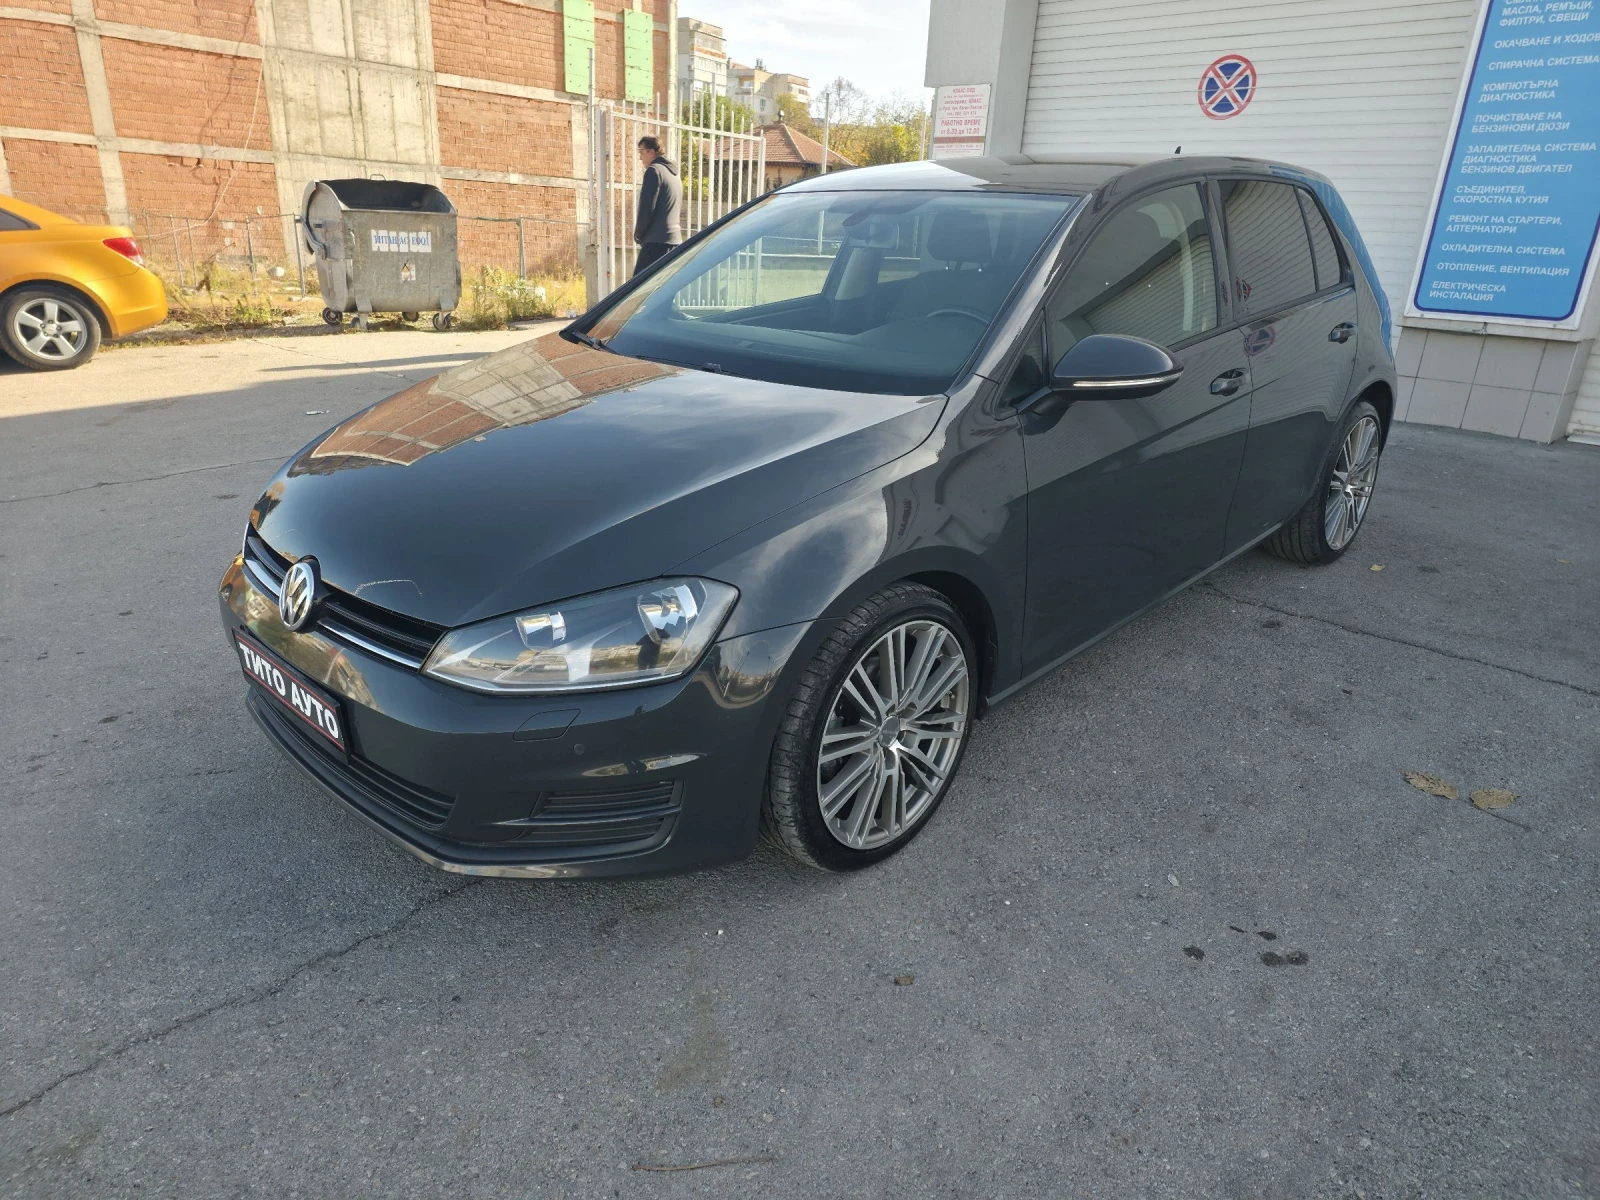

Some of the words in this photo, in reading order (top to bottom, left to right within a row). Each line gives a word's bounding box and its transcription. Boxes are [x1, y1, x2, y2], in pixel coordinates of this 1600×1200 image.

[1502, 7, 1542, 16] МАСЛА,
[1545, 1, 1594, 12] РЕМЪЦИ,
[1500, 15, 1545, 26] ФИЛТРИ,
[1548, 12, 1589, 22] СВЕЩИ
[1494, 36, 1551, 49] ОКАЧВАНЕ
[1553, 35, 1562, 44] И
[1488, 58, 1544, 70] СПИРАЧНА
[1547, 55, 1599, 66] СИСТЕМА
[1482, 80, 1559, 92] КОМПЮТЪРНА
[1478, 91, 1556, 103] ДИАГНОСТИКА
[964, 118, 982, 126] ВРЕМЕ
[1475, 113, 1545, 123] ПОЧИСТВАНЕ
[1547, 112, 1562, 120] НА
[1471, 123, 1535, 133] БЕНЗИНОВИ
[1536, 122, 1570, 132] ДЮЗИ
[1467, 145, 1541, 153] ЗАПАЛИТЕЛНА
[1544, 143, 1597, 152] СИСТЕМА
[1463, 155, 1537, 164] ДИАГНОСТИКА
[1461, 165, 1515, 174] БЕНЗИНОВ
[1516, 164, 1573, 174] ДВИГАТЕЛ
[1456, 185, 1526, 195] СЪЕДИНИТЕЛ,
[1453, 195, 1512, 204] СКОРОСТНА
[1515, 196, 1549, 204] КУТИЯ
[1449, 215, 1489, 223] РЕМОНТ
[1490, 216, 1505, 224] НА
[1507, 215, 1563, 226] СТАРТЕРИ,
[1446, 225, 1517, 234] АЛТЕРНАТОРИ
[1442, 244, 1513, 254] ОХЛАДИТЕЛНА
[1516, 246, 1566, 256] СИСТЕМА
[1437, 262, 1497, 274] ОТОПЛЕНИЕ,
[1500, 265, 1570, 277] ВЕНТИЛАЦИЯ
[1432, 281, 1507, 293] ЕЛЕКТРИЧЕСКА
[1429, 290, 1494, 302] ИНСТАЛАЦИЯ
[238, 641, 287, 697] ТИТО
[291, 681, 339, 739] АУТО
